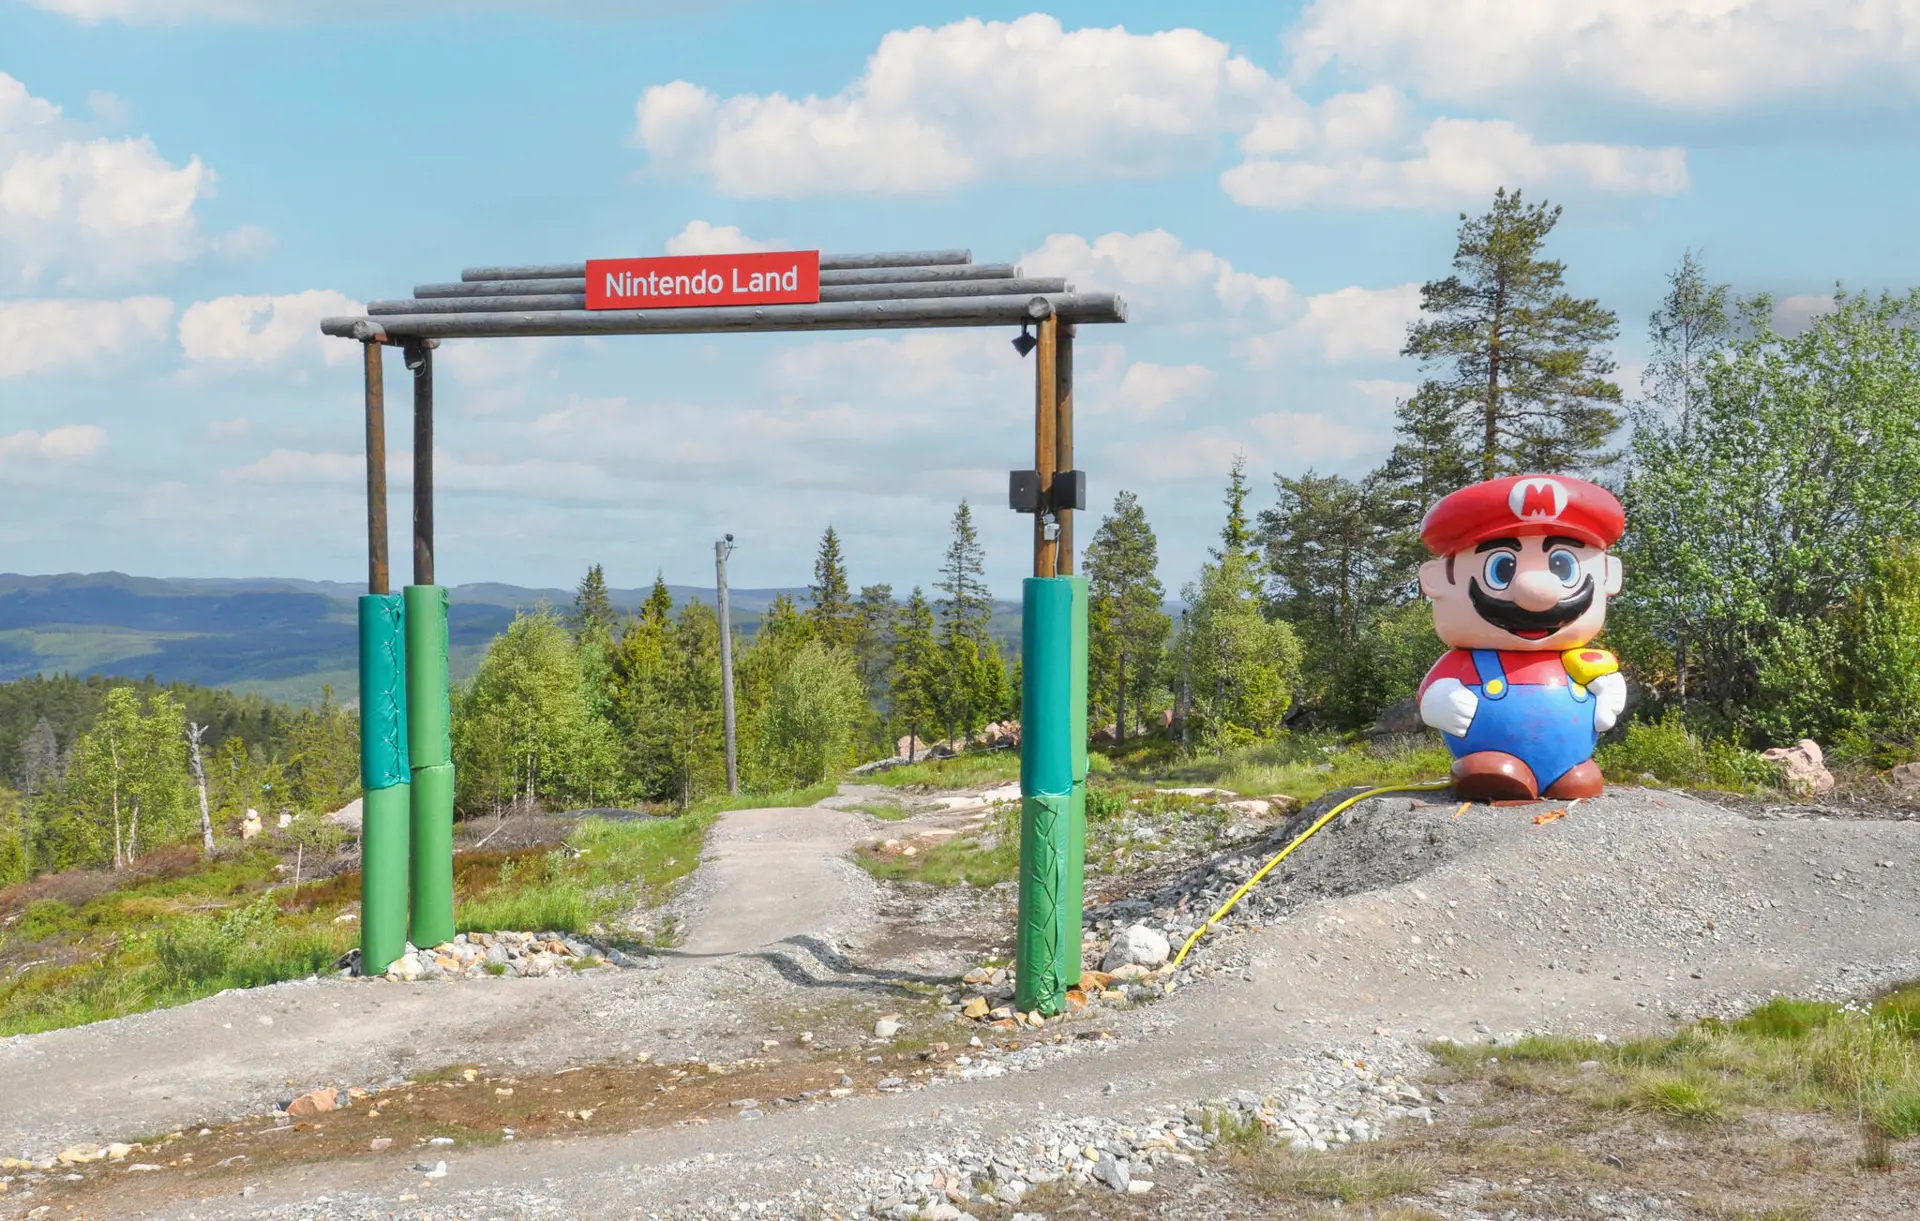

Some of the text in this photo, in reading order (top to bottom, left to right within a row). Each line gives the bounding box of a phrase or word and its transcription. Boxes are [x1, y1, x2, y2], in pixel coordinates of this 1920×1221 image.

[606, 265, 798, 297] Nintendo Land
[1521, 484, 1557, 516] M
